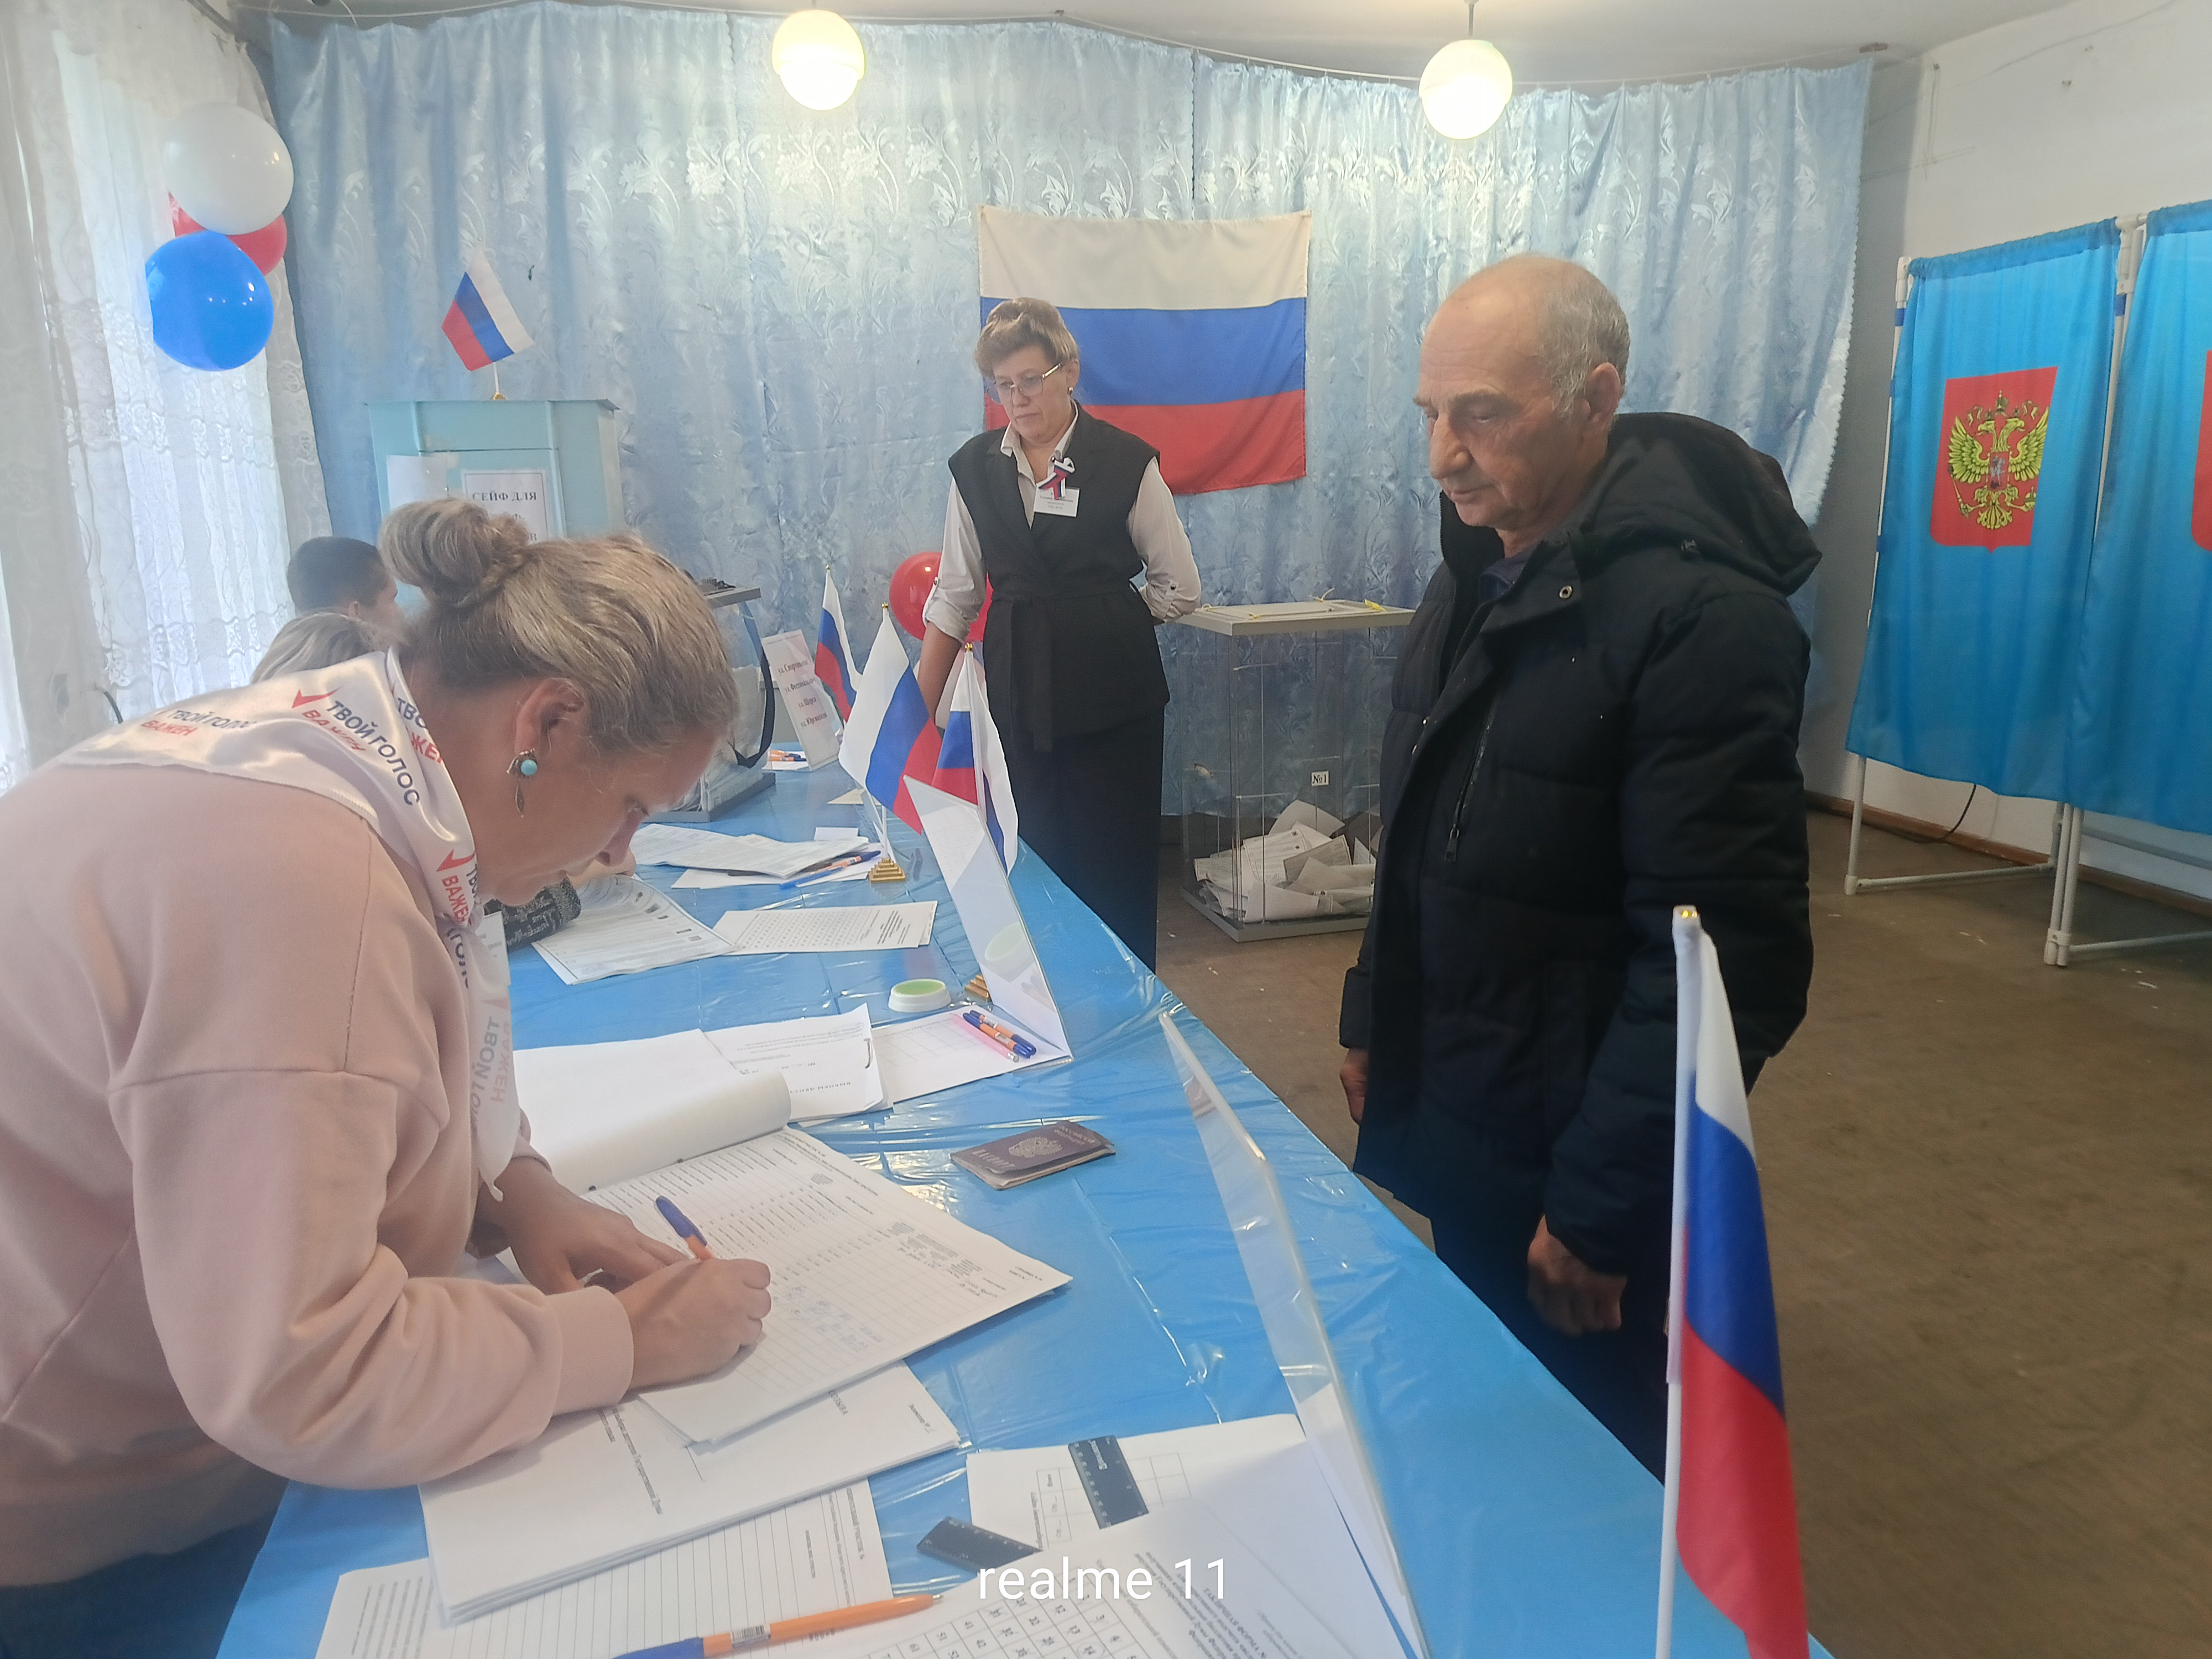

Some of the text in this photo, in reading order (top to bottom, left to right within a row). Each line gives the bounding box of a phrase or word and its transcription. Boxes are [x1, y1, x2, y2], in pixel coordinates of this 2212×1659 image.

[472, 490, 536, 502] СЕЙФ ДЛЯ
[398, 697, 429, 729] ТВО
[327, 701, 420, 805] ТВОЙ ГОЛОС
